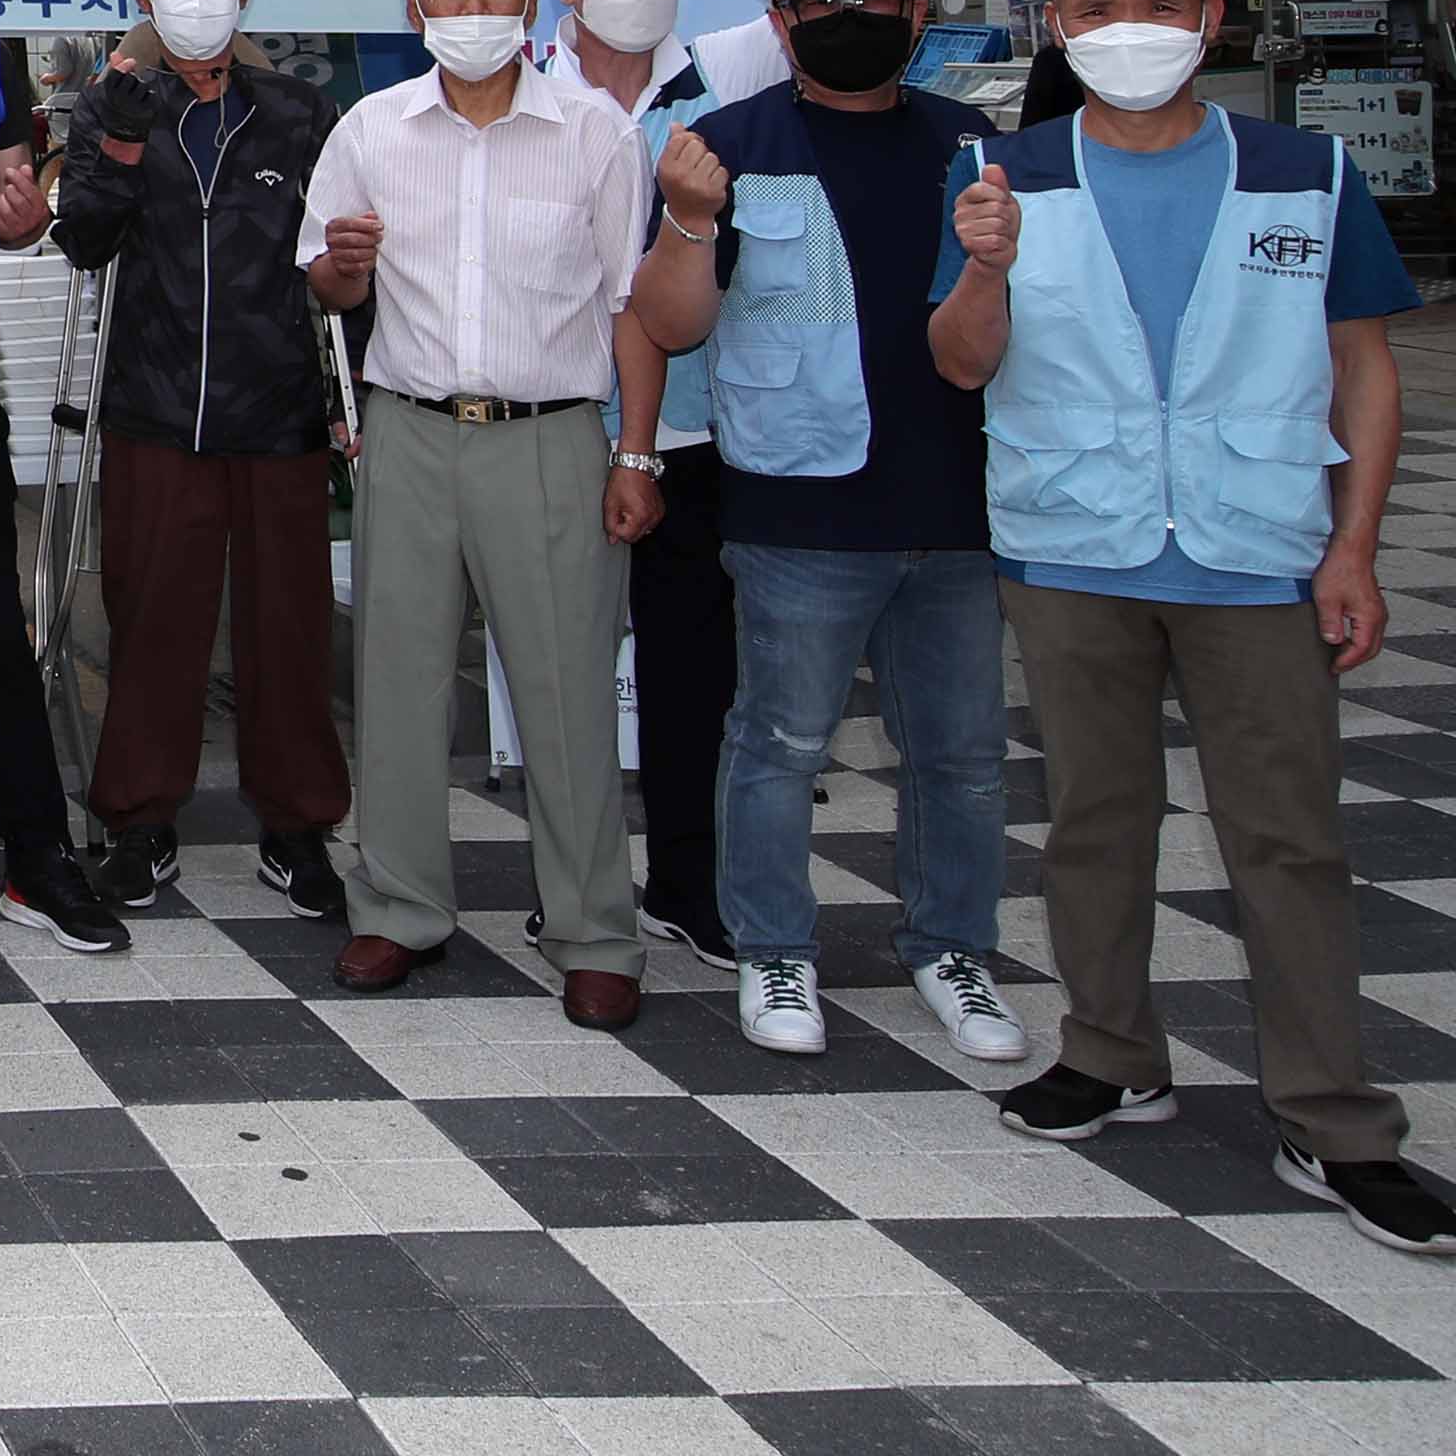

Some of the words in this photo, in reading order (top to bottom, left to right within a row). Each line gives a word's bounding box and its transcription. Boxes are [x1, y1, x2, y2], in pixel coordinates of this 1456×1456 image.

[1357, 97, 1386, 112] 1+1
[1358, 133, 1387, 148] 1+1
[1249, 233, 1324, 264] KFF
